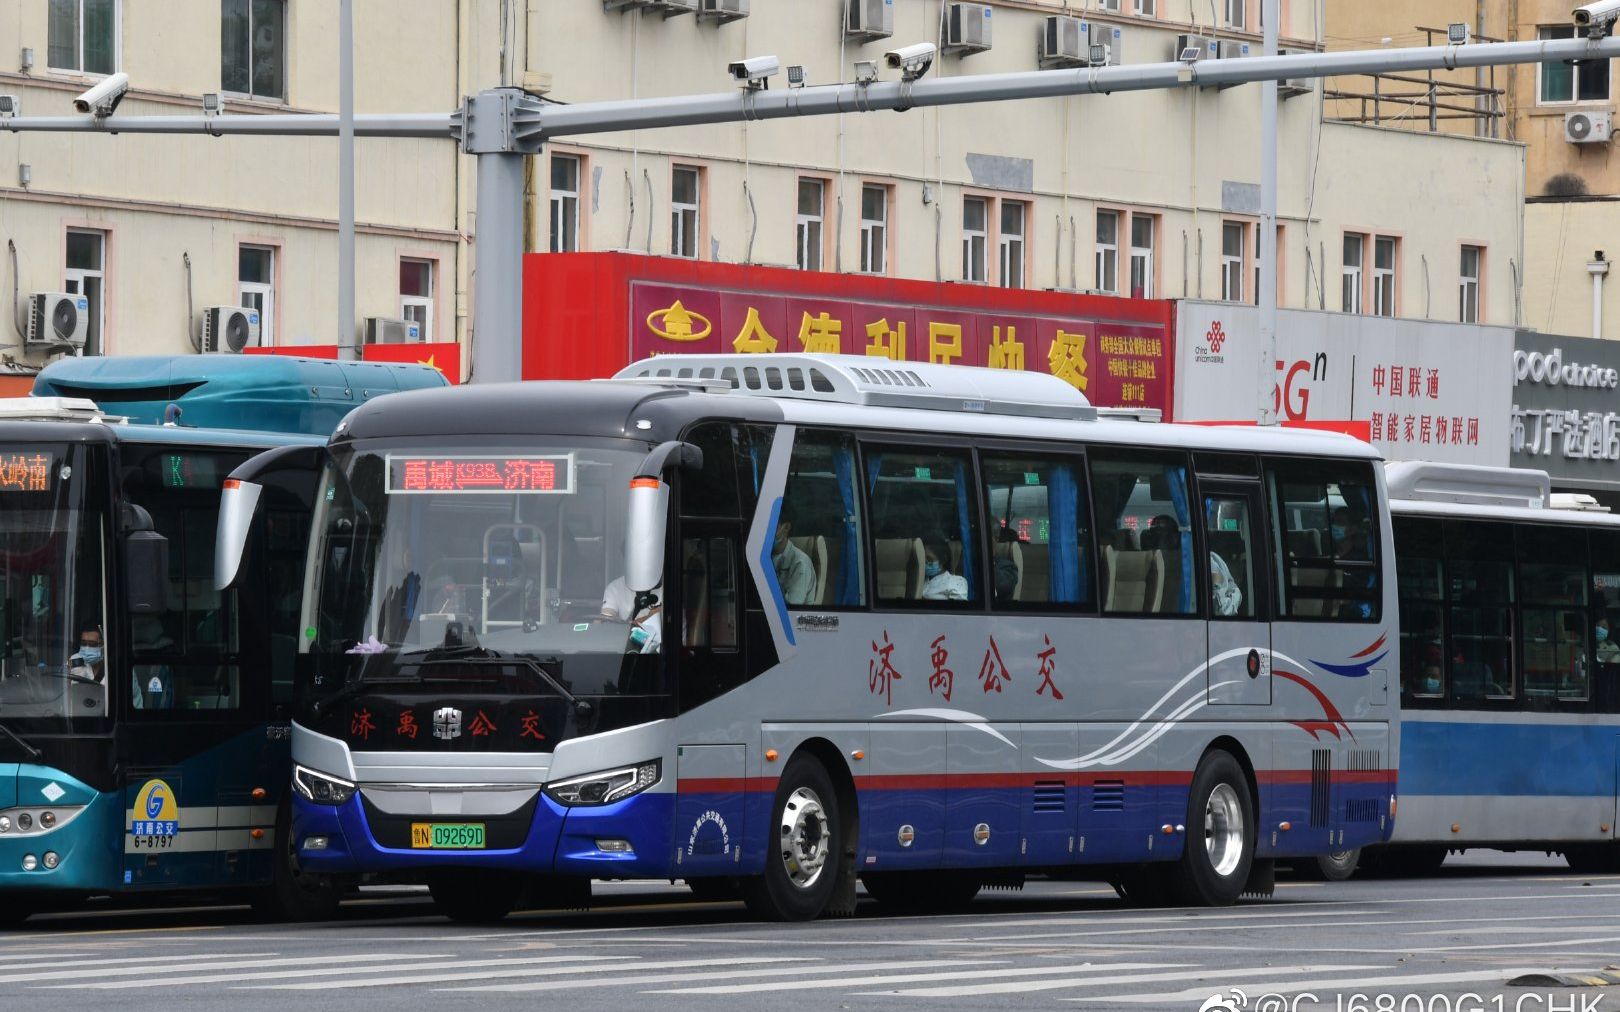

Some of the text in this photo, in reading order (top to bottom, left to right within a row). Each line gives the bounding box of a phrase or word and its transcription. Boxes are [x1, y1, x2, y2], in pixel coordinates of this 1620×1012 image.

[1372, 364, 1440, 399] 中国联通
[1562, 362, 1618, 388] choice
[1371, 411, 1480, 446] 智能家居物联网
[404, 460, 455, 490] 禹城
[504, 460, 556, 490] 济南
[868, 629, 1064, 706] 济禹公交
[352, 707, 546, 740] 济禹公交
[134, 835, 173, 849] 6-8797
[135, 821, 174, 835] 济南公交
